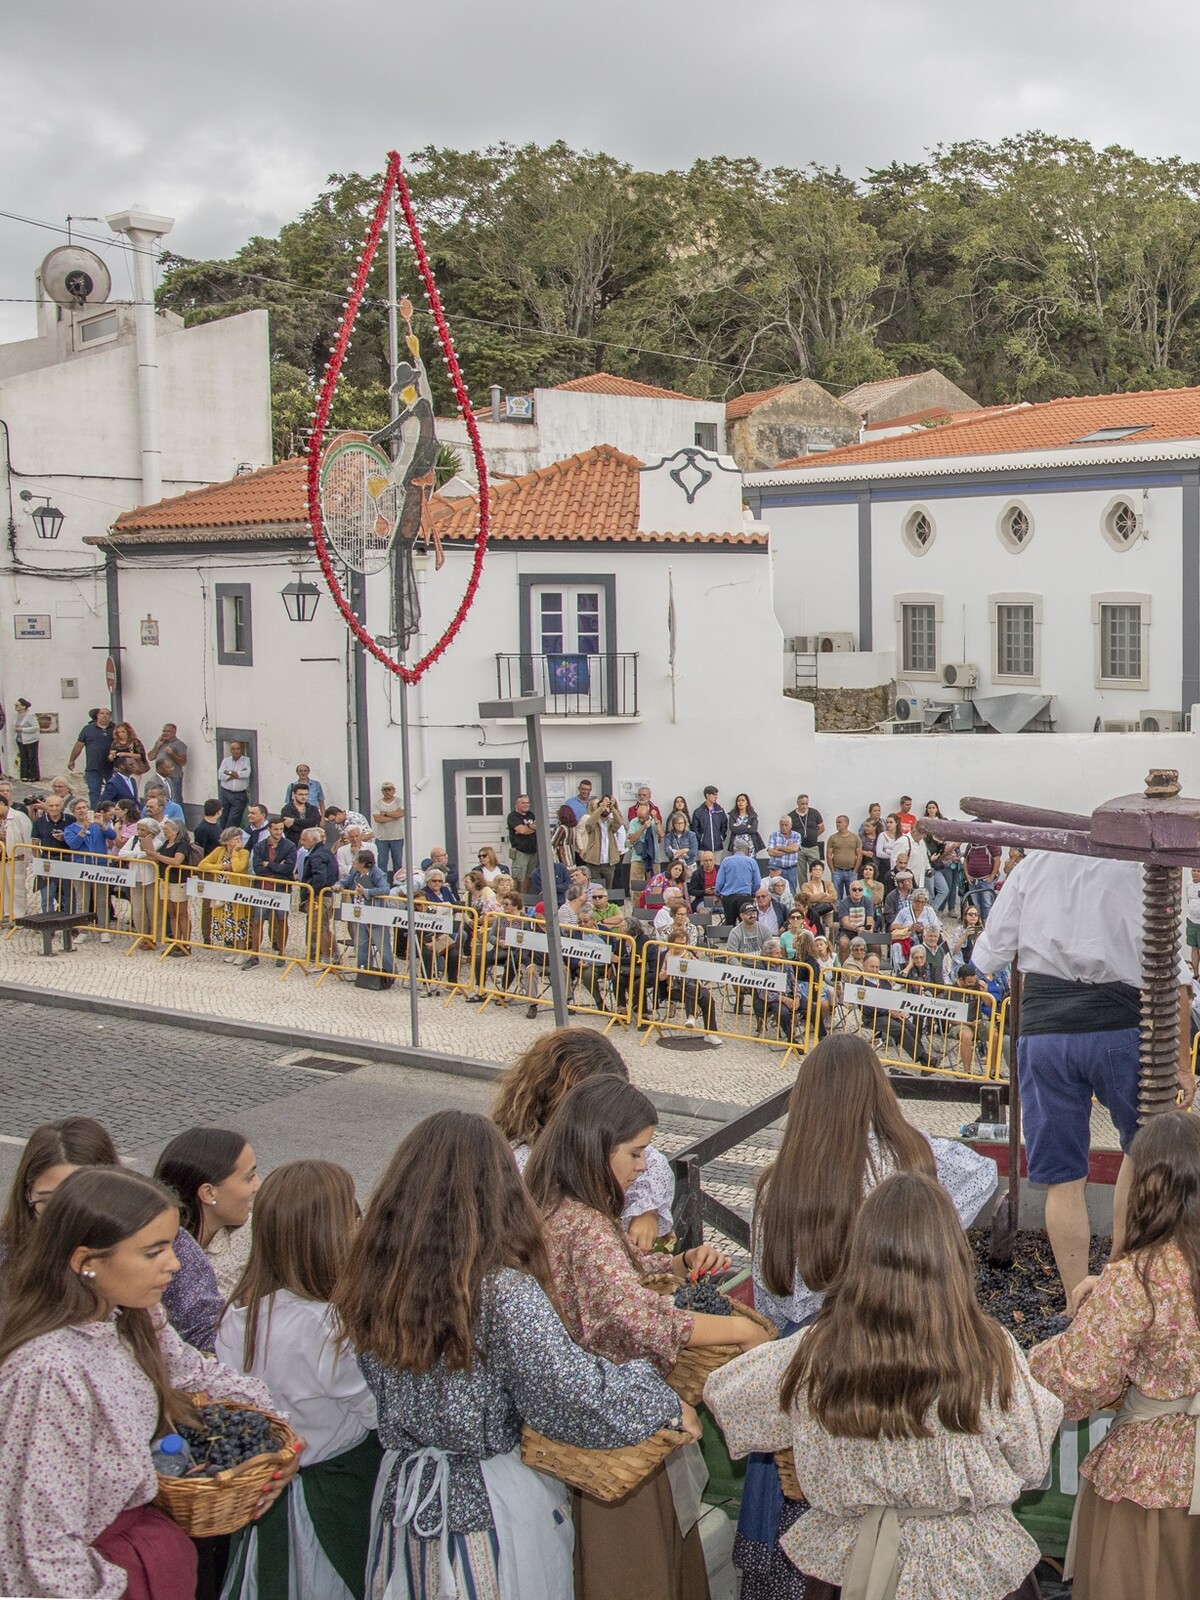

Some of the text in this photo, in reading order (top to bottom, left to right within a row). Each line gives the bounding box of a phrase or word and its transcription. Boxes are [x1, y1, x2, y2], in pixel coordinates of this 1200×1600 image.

[80, 870, 126, 884] Palmela
[234, 893, 280, 908] Palmela
[392, 916, 443, 930] Pamela
[560, 946, 601, 959] almela
[721, 972, 776, 988] Palmela
[900, 1000, 956, 1018] Palmela
